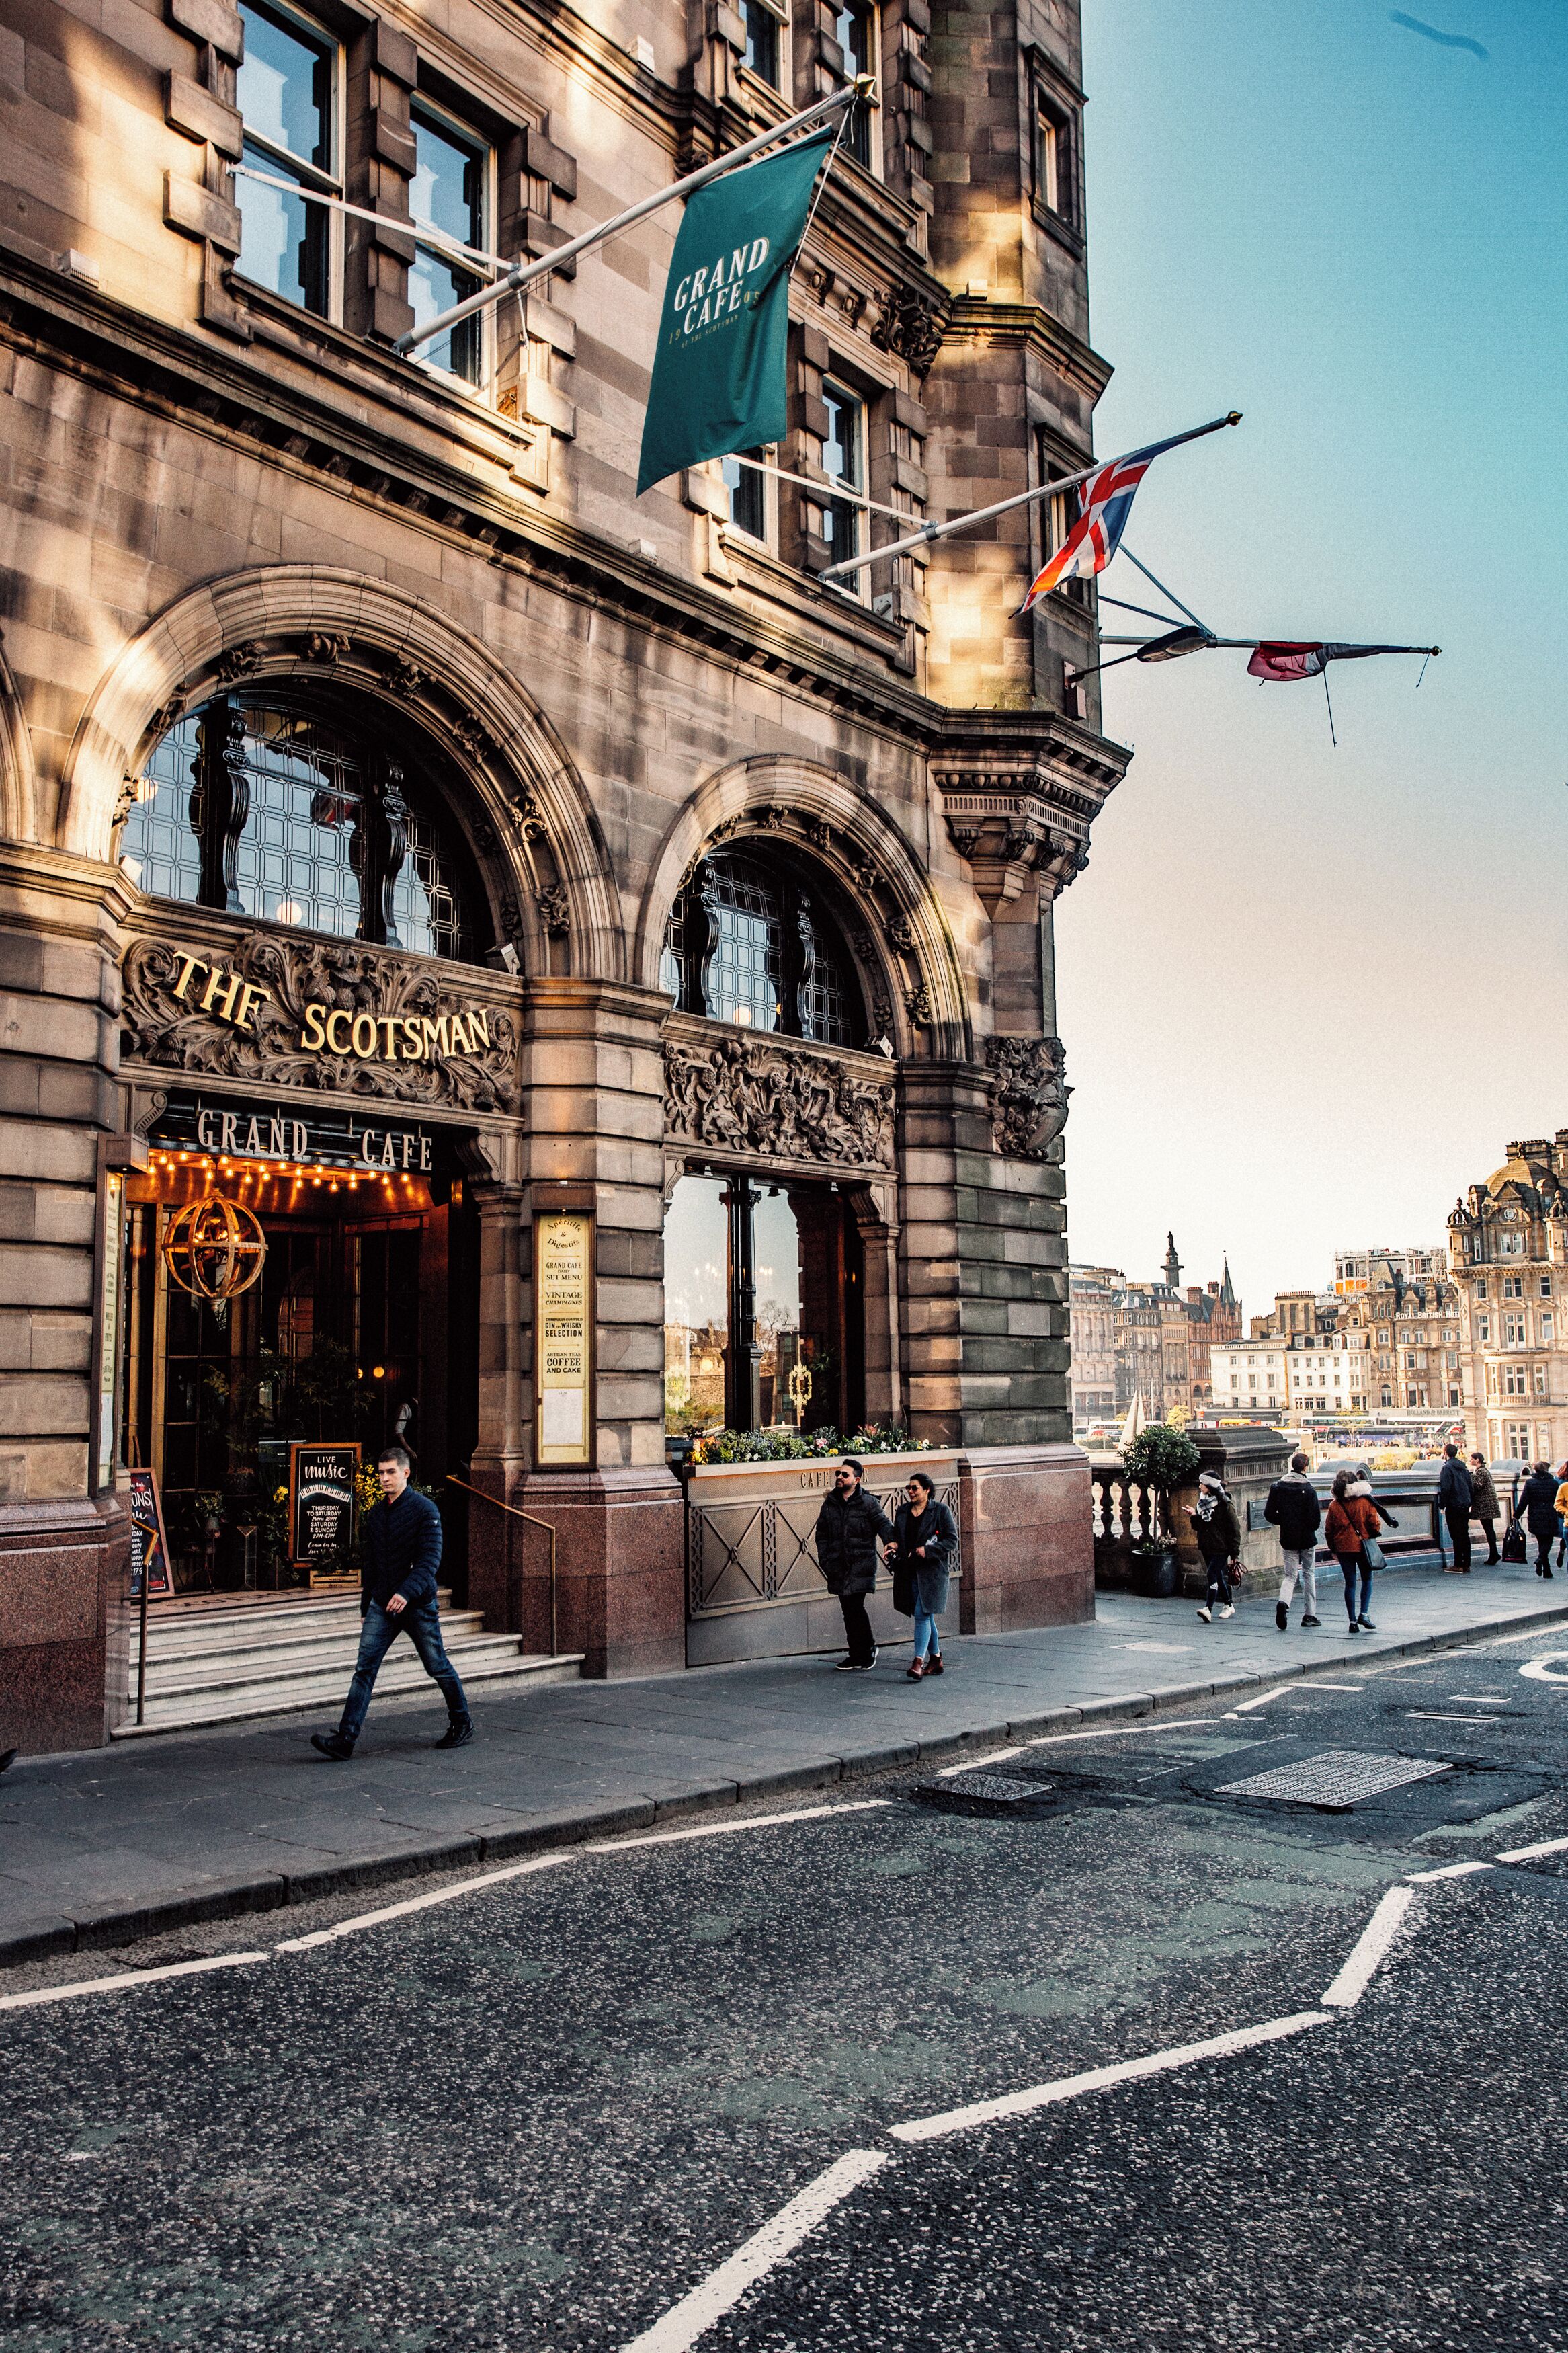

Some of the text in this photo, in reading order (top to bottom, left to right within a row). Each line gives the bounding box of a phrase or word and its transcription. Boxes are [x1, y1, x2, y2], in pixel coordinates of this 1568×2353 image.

[674, 237, 770, 311] GRAND
[684, 279, 744, 334] CAFE
[173, 950, 491, 1060] THE SCOTSMAN
[198, 1109, 433, 1171] GRAND CAFE
[547, 1218, 581, 1232] Apéritifs
[548, 1238, 580, 1249] Digestifs
[1395, 1312, 1415, 1320] ROYAL
[1417, 1311, 1443, 1319] BRITISH
[547, 1358, 581, 1366] COFFEE
[304, 1464, 348, 1479] music
[800, 1471, 829, 1488] CAFE
[132, 1491, 151, 1507] ONS
